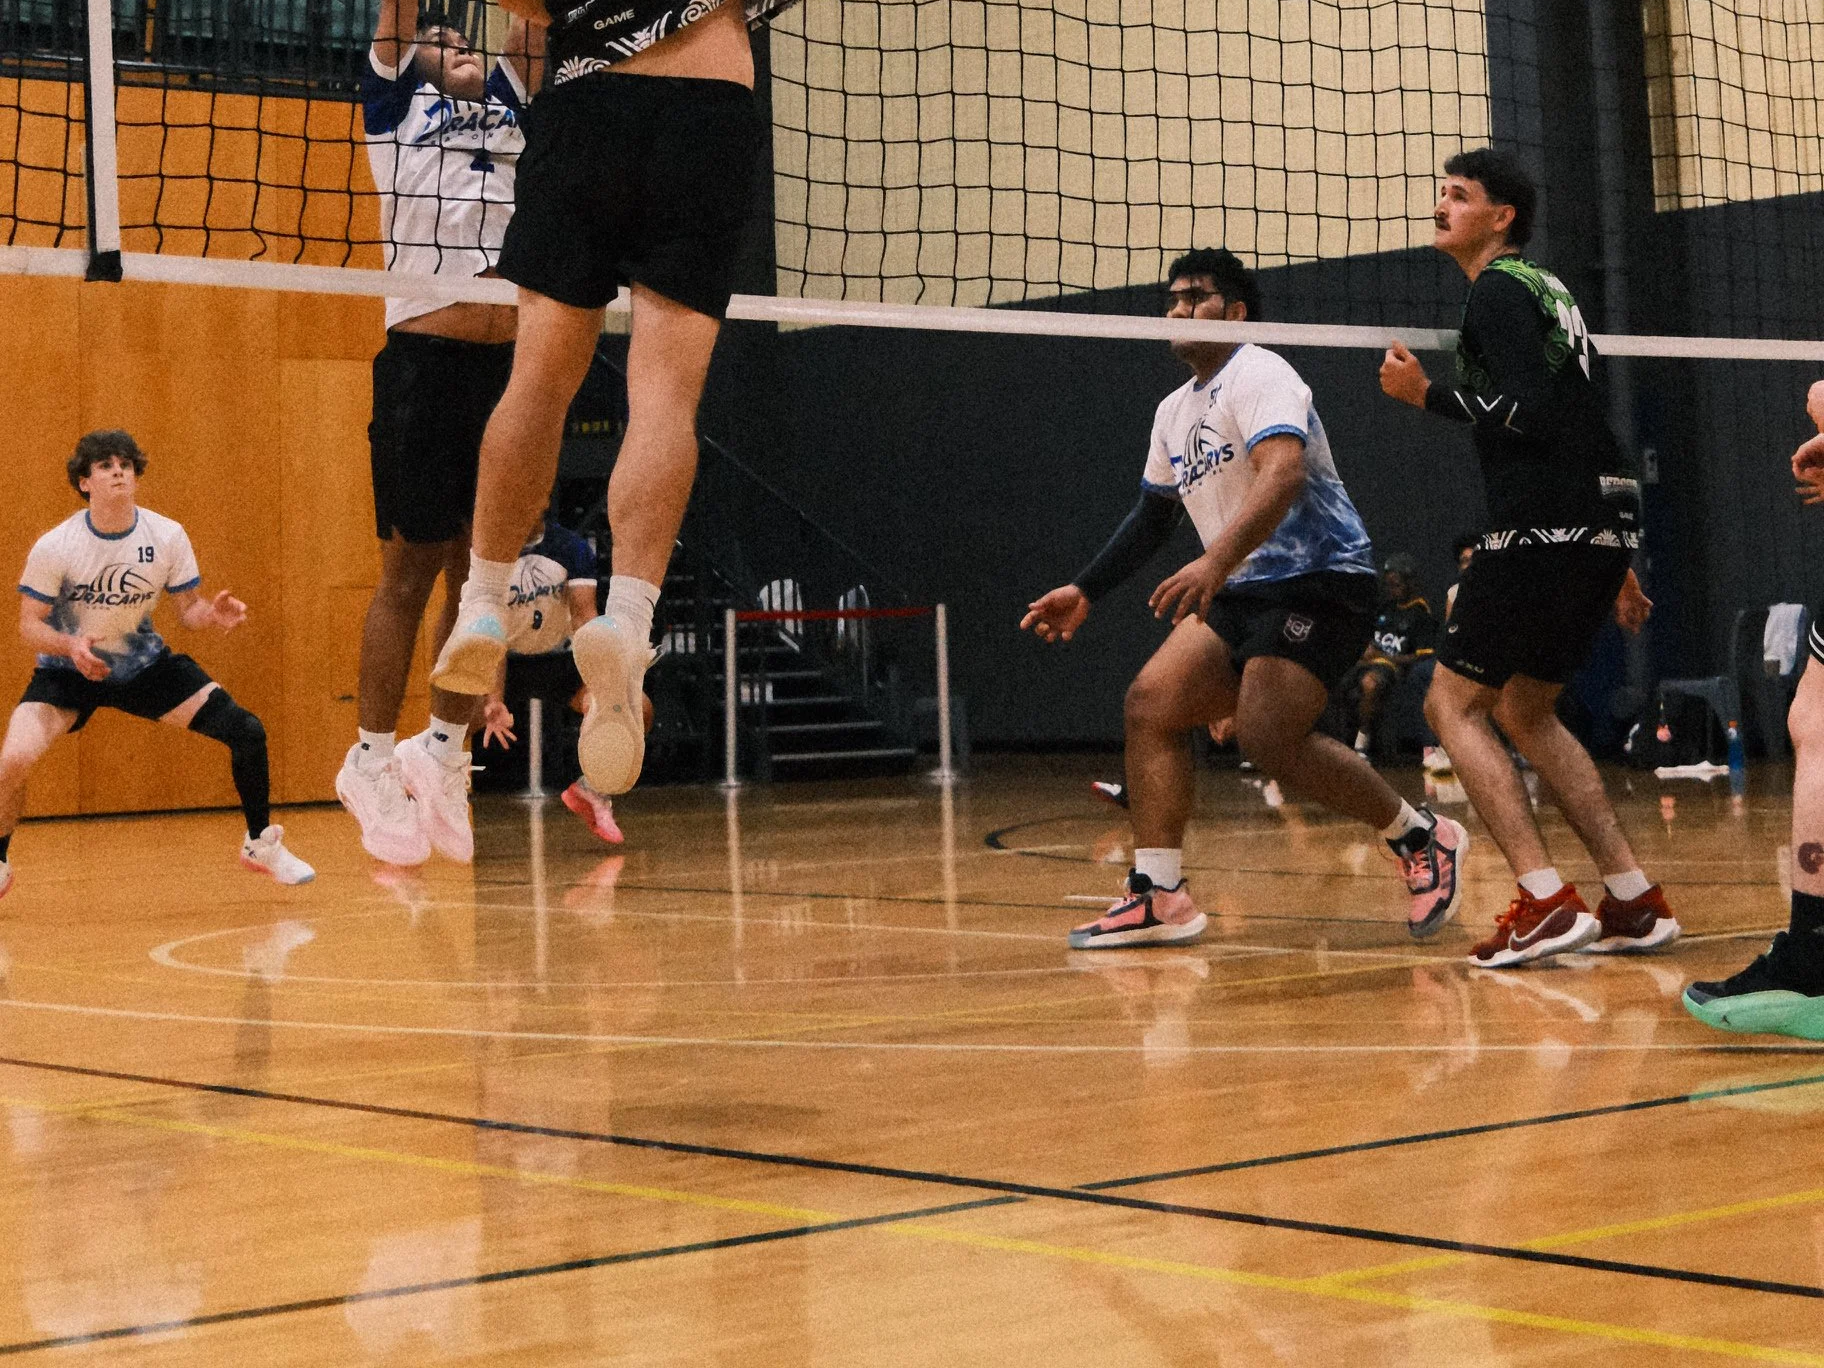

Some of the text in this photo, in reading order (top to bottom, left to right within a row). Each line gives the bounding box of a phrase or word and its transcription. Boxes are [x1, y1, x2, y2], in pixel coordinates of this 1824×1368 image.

[593, 8, 636, 31] GAME
[138, 545, 155, 563] 19
[67, 584, 156, 606] DRACARYS
